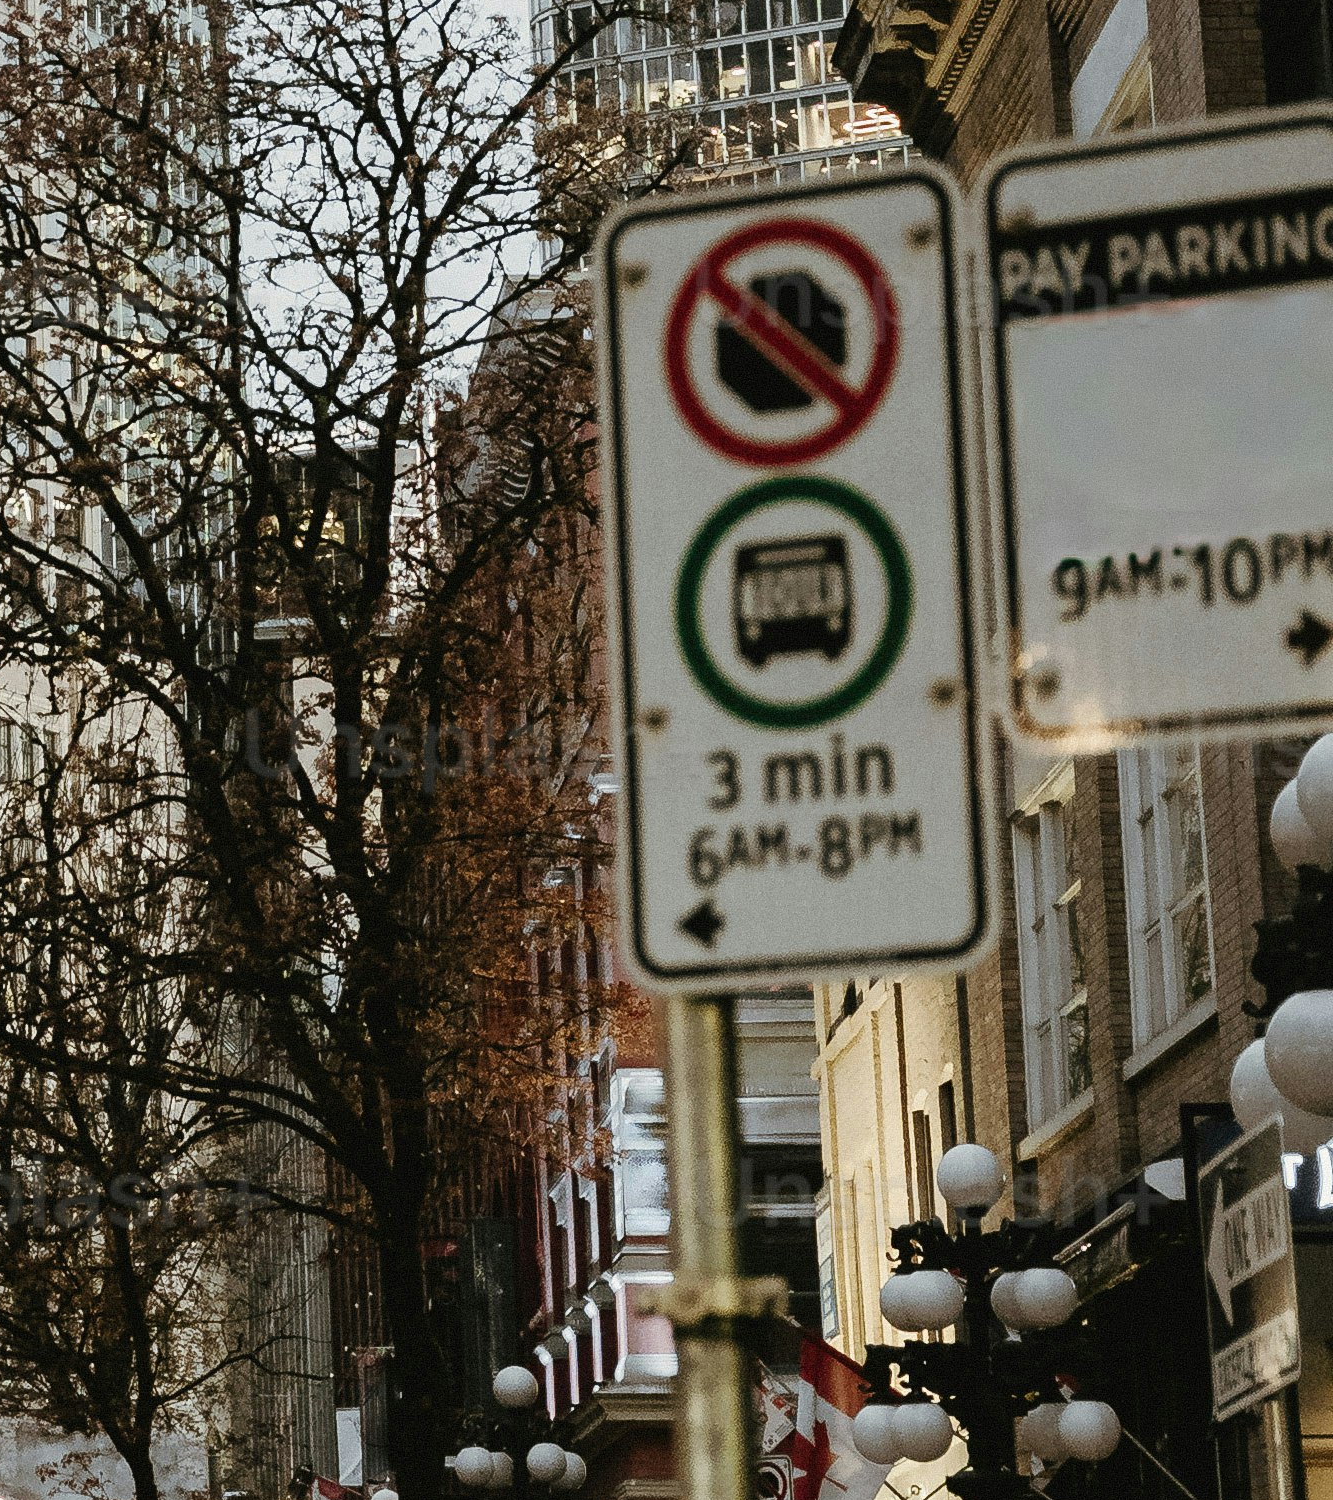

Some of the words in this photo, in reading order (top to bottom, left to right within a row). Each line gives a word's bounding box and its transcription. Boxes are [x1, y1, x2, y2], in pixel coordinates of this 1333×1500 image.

[999, 240, 1092, 301] PAY
[704, 745, 745, 814] 3
[761, 730, 897, 806] min
[686, 808, 924, 890] 6AM-8PM
